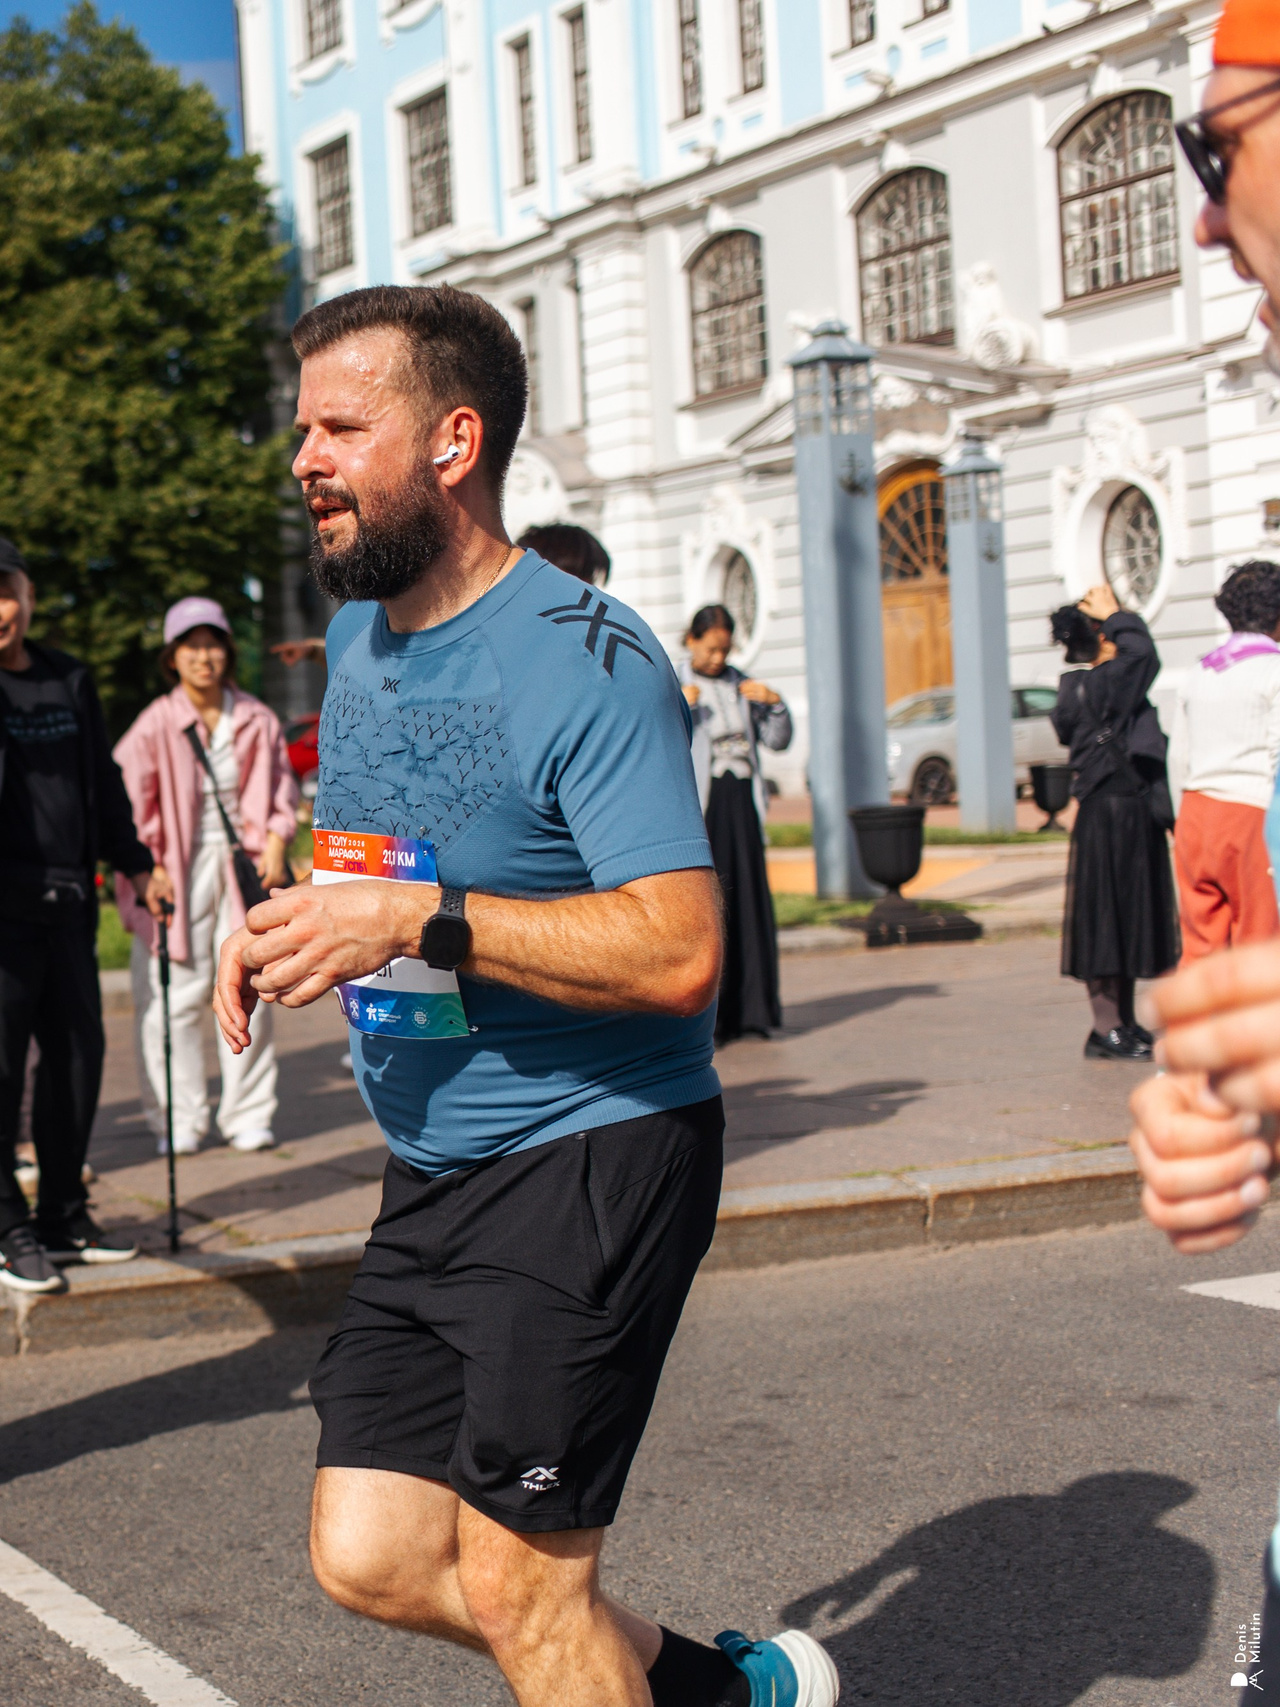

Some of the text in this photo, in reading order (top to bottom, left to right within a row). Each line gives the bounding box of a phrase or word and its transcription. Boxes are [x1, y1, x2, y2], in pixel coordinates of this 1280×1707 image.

[328, 835, 348, 847] ПОЛУ
[328, 847, 366, 861] МАРАФОН
[382, 849, 396, 867] 21,1
